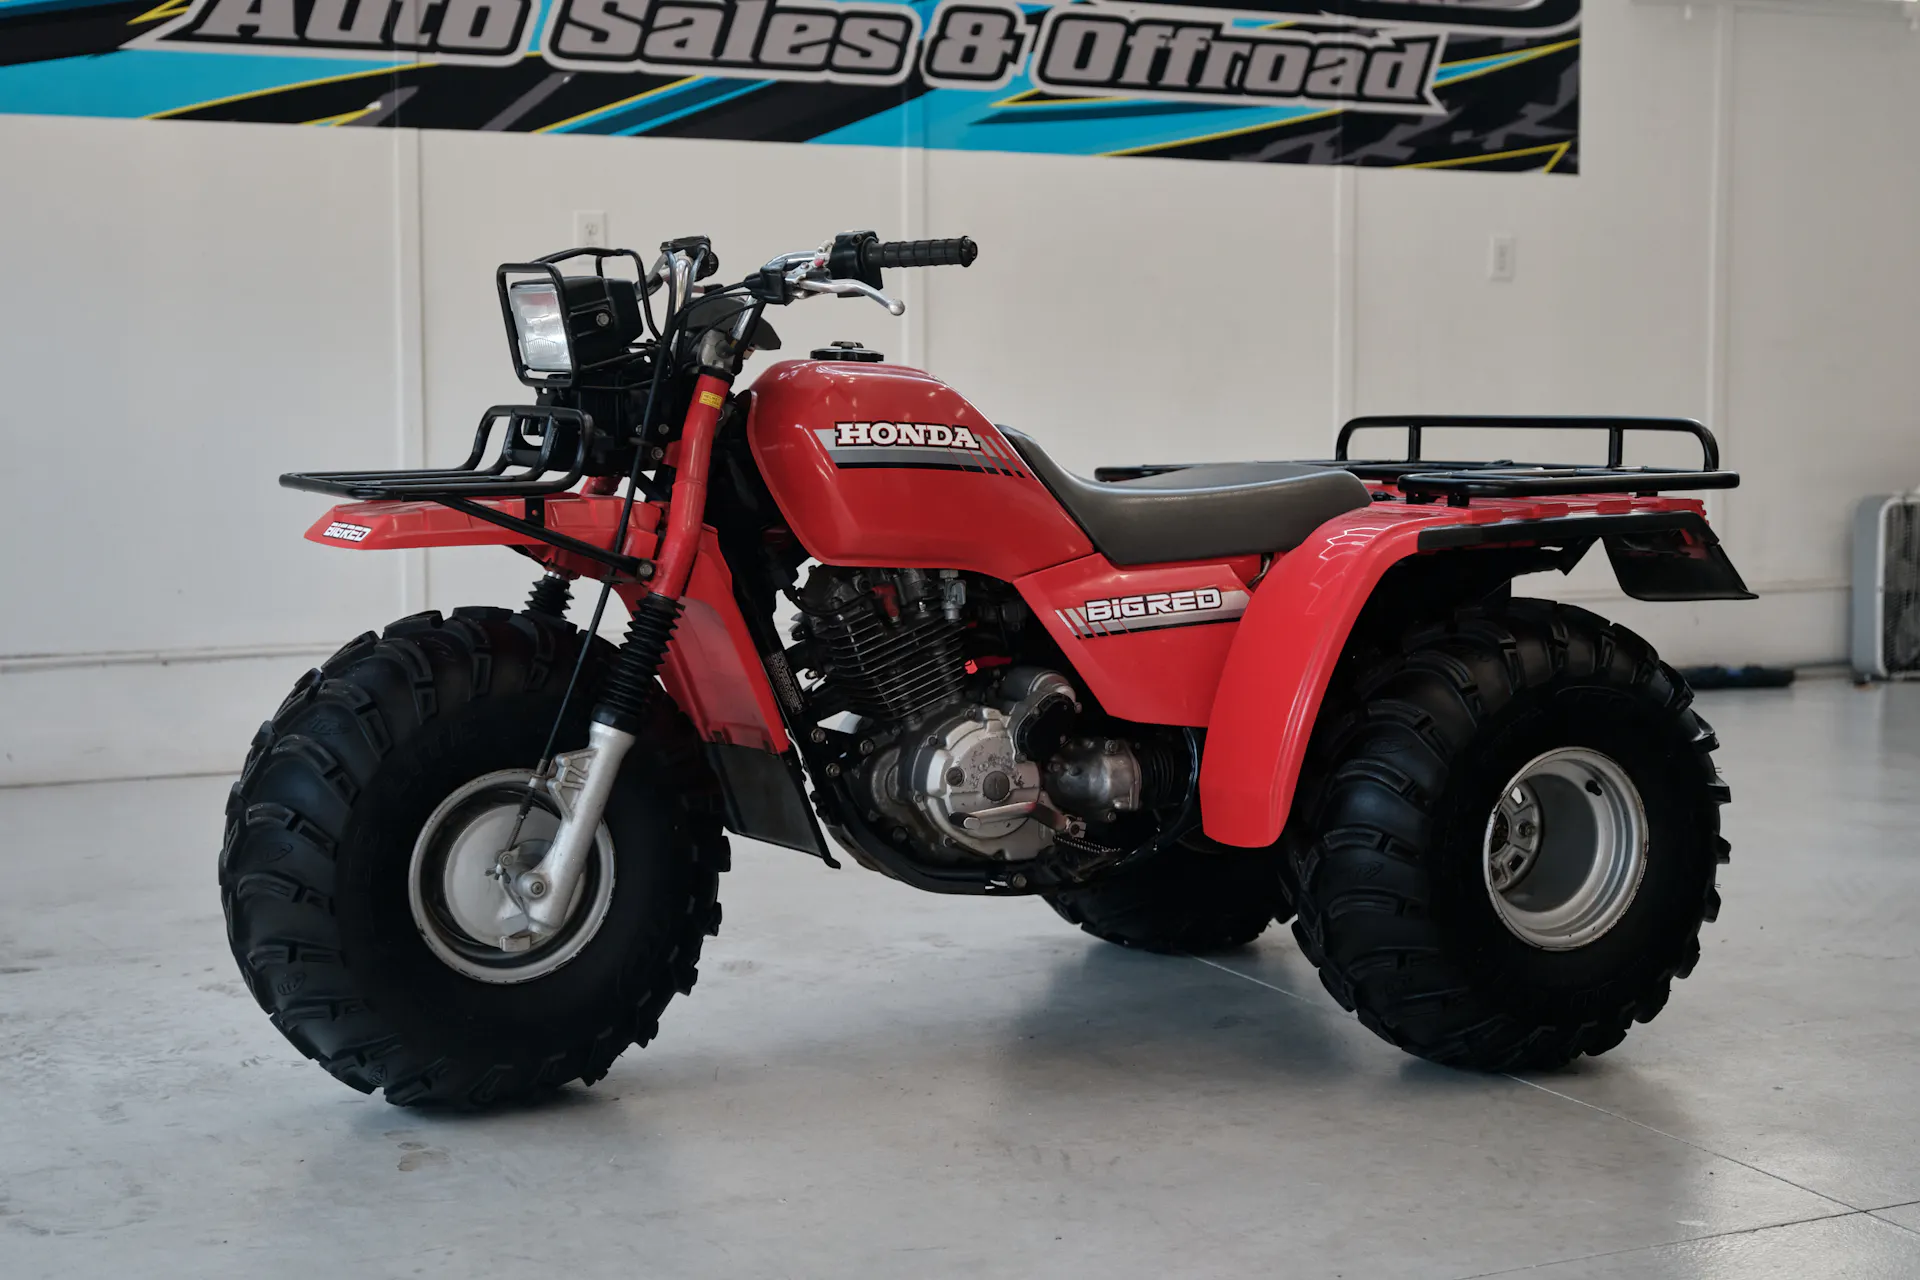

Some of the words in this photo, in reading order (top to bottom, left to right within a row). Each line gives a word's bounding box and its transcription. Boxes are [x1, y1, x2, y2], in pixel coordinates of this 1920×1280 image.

[189, 0, 522, 50] Auto
[557, 0, 907, 71] Sales
[929, 10, 1018, 76] &
[1042, 19, 1432, 99] Offroad
[835, 421, 980, 449] HONDA
